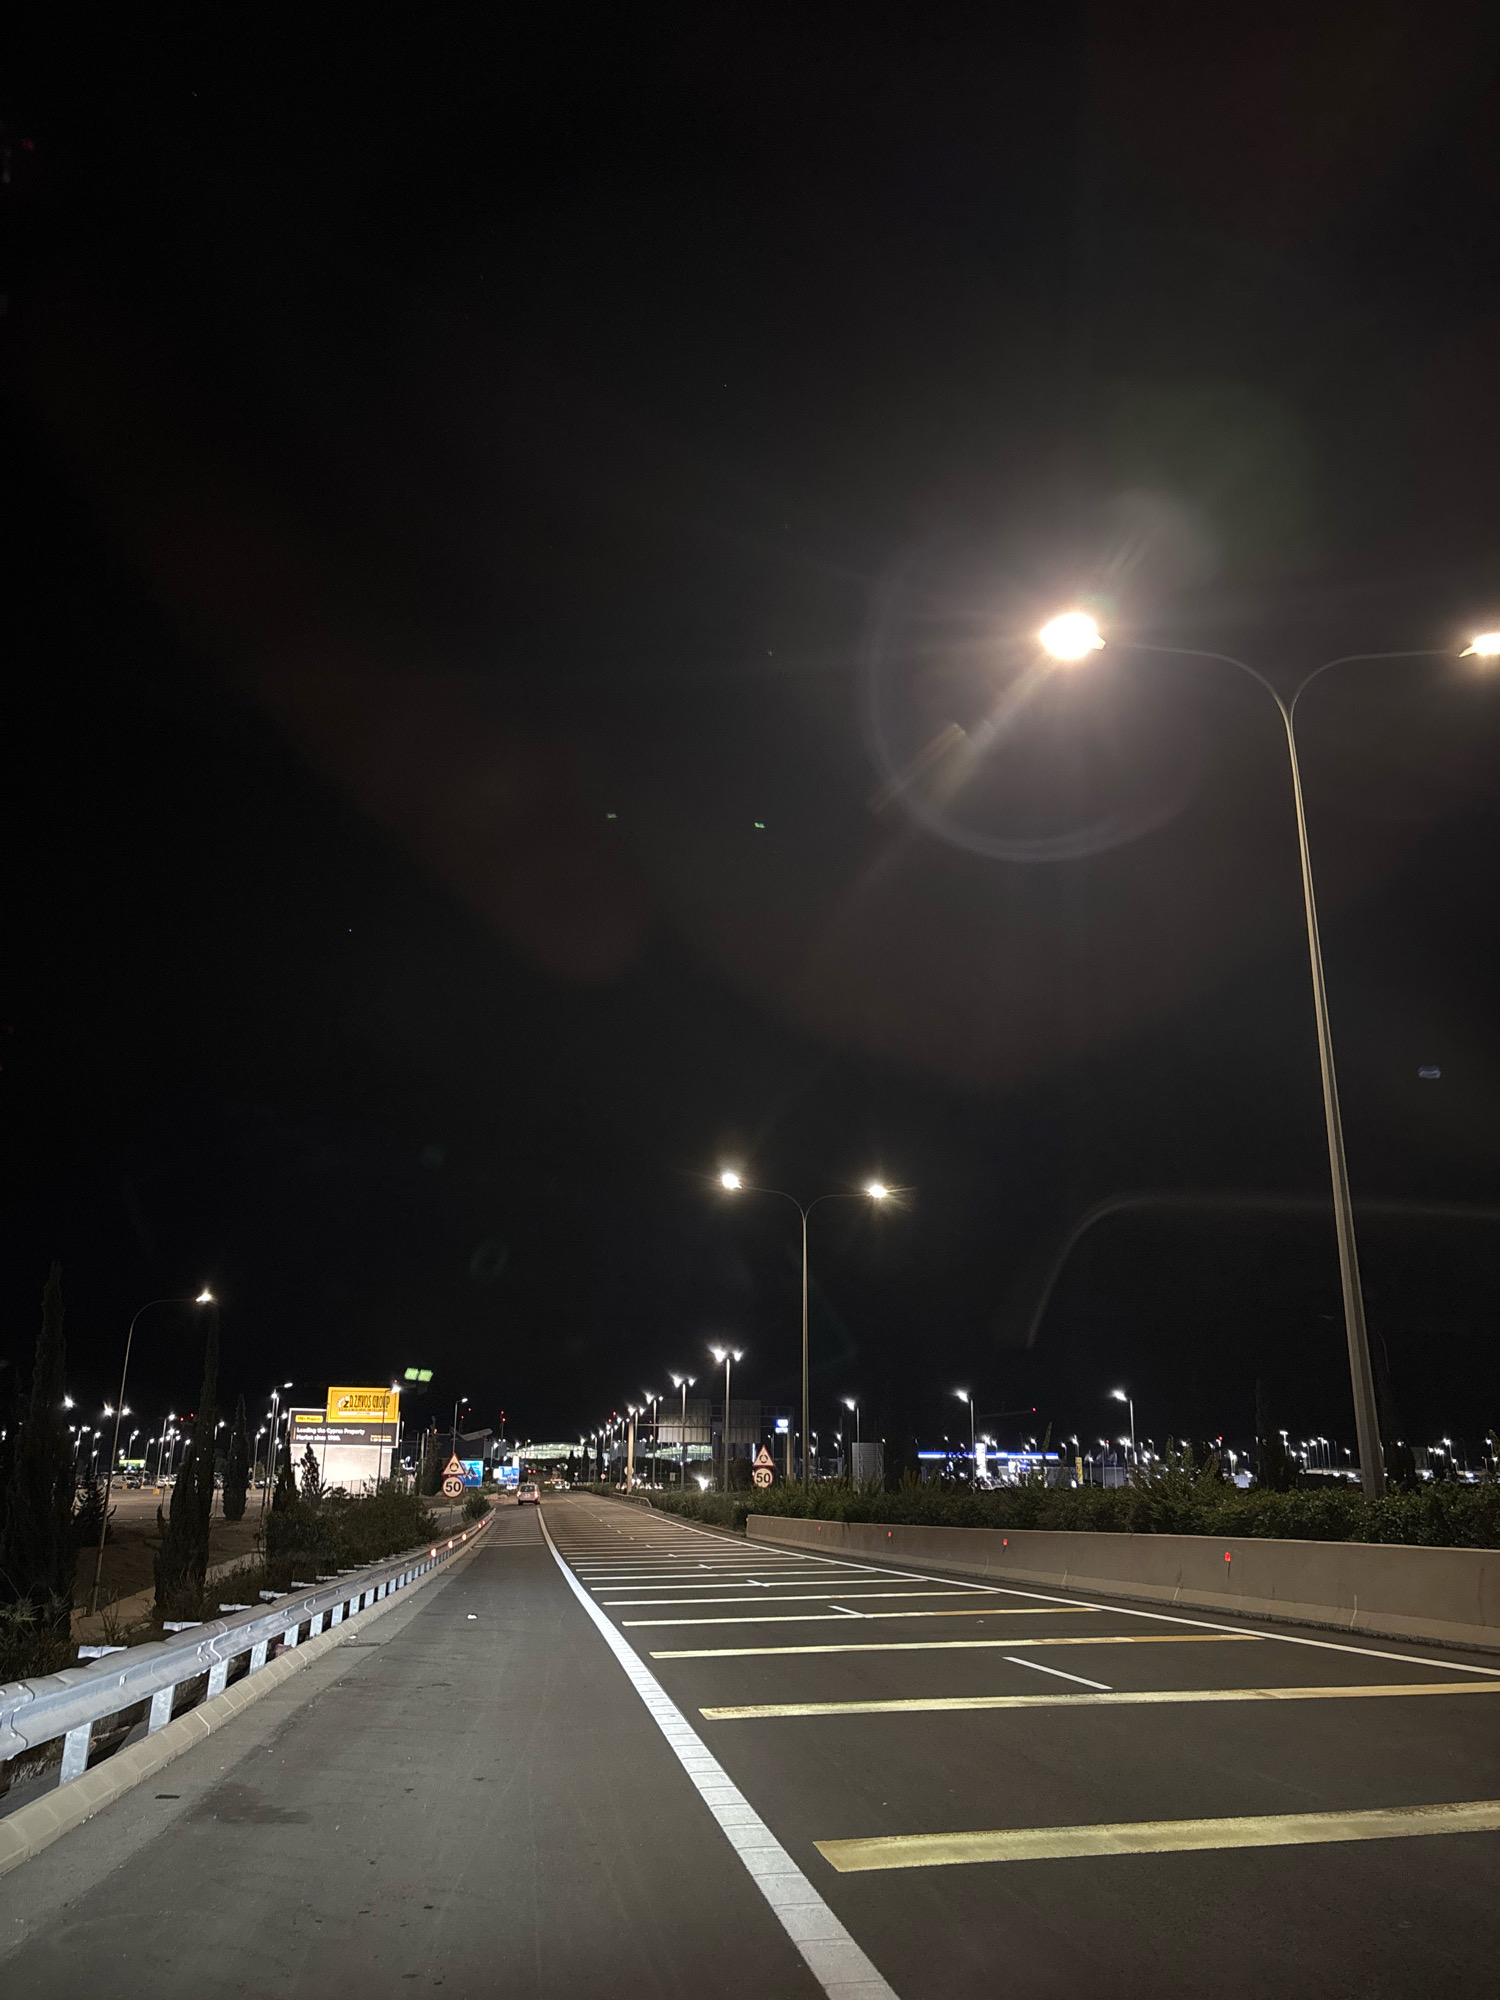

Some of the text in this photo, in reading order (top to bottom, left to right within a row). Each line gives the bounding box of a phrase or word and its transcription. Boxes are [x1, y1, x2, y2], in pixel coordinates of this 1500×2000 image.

[372, 1395, 391, 1408] GROUP
[756, 1472, 771, 1483] 50
[445, 1481, 461, 1493] 50
